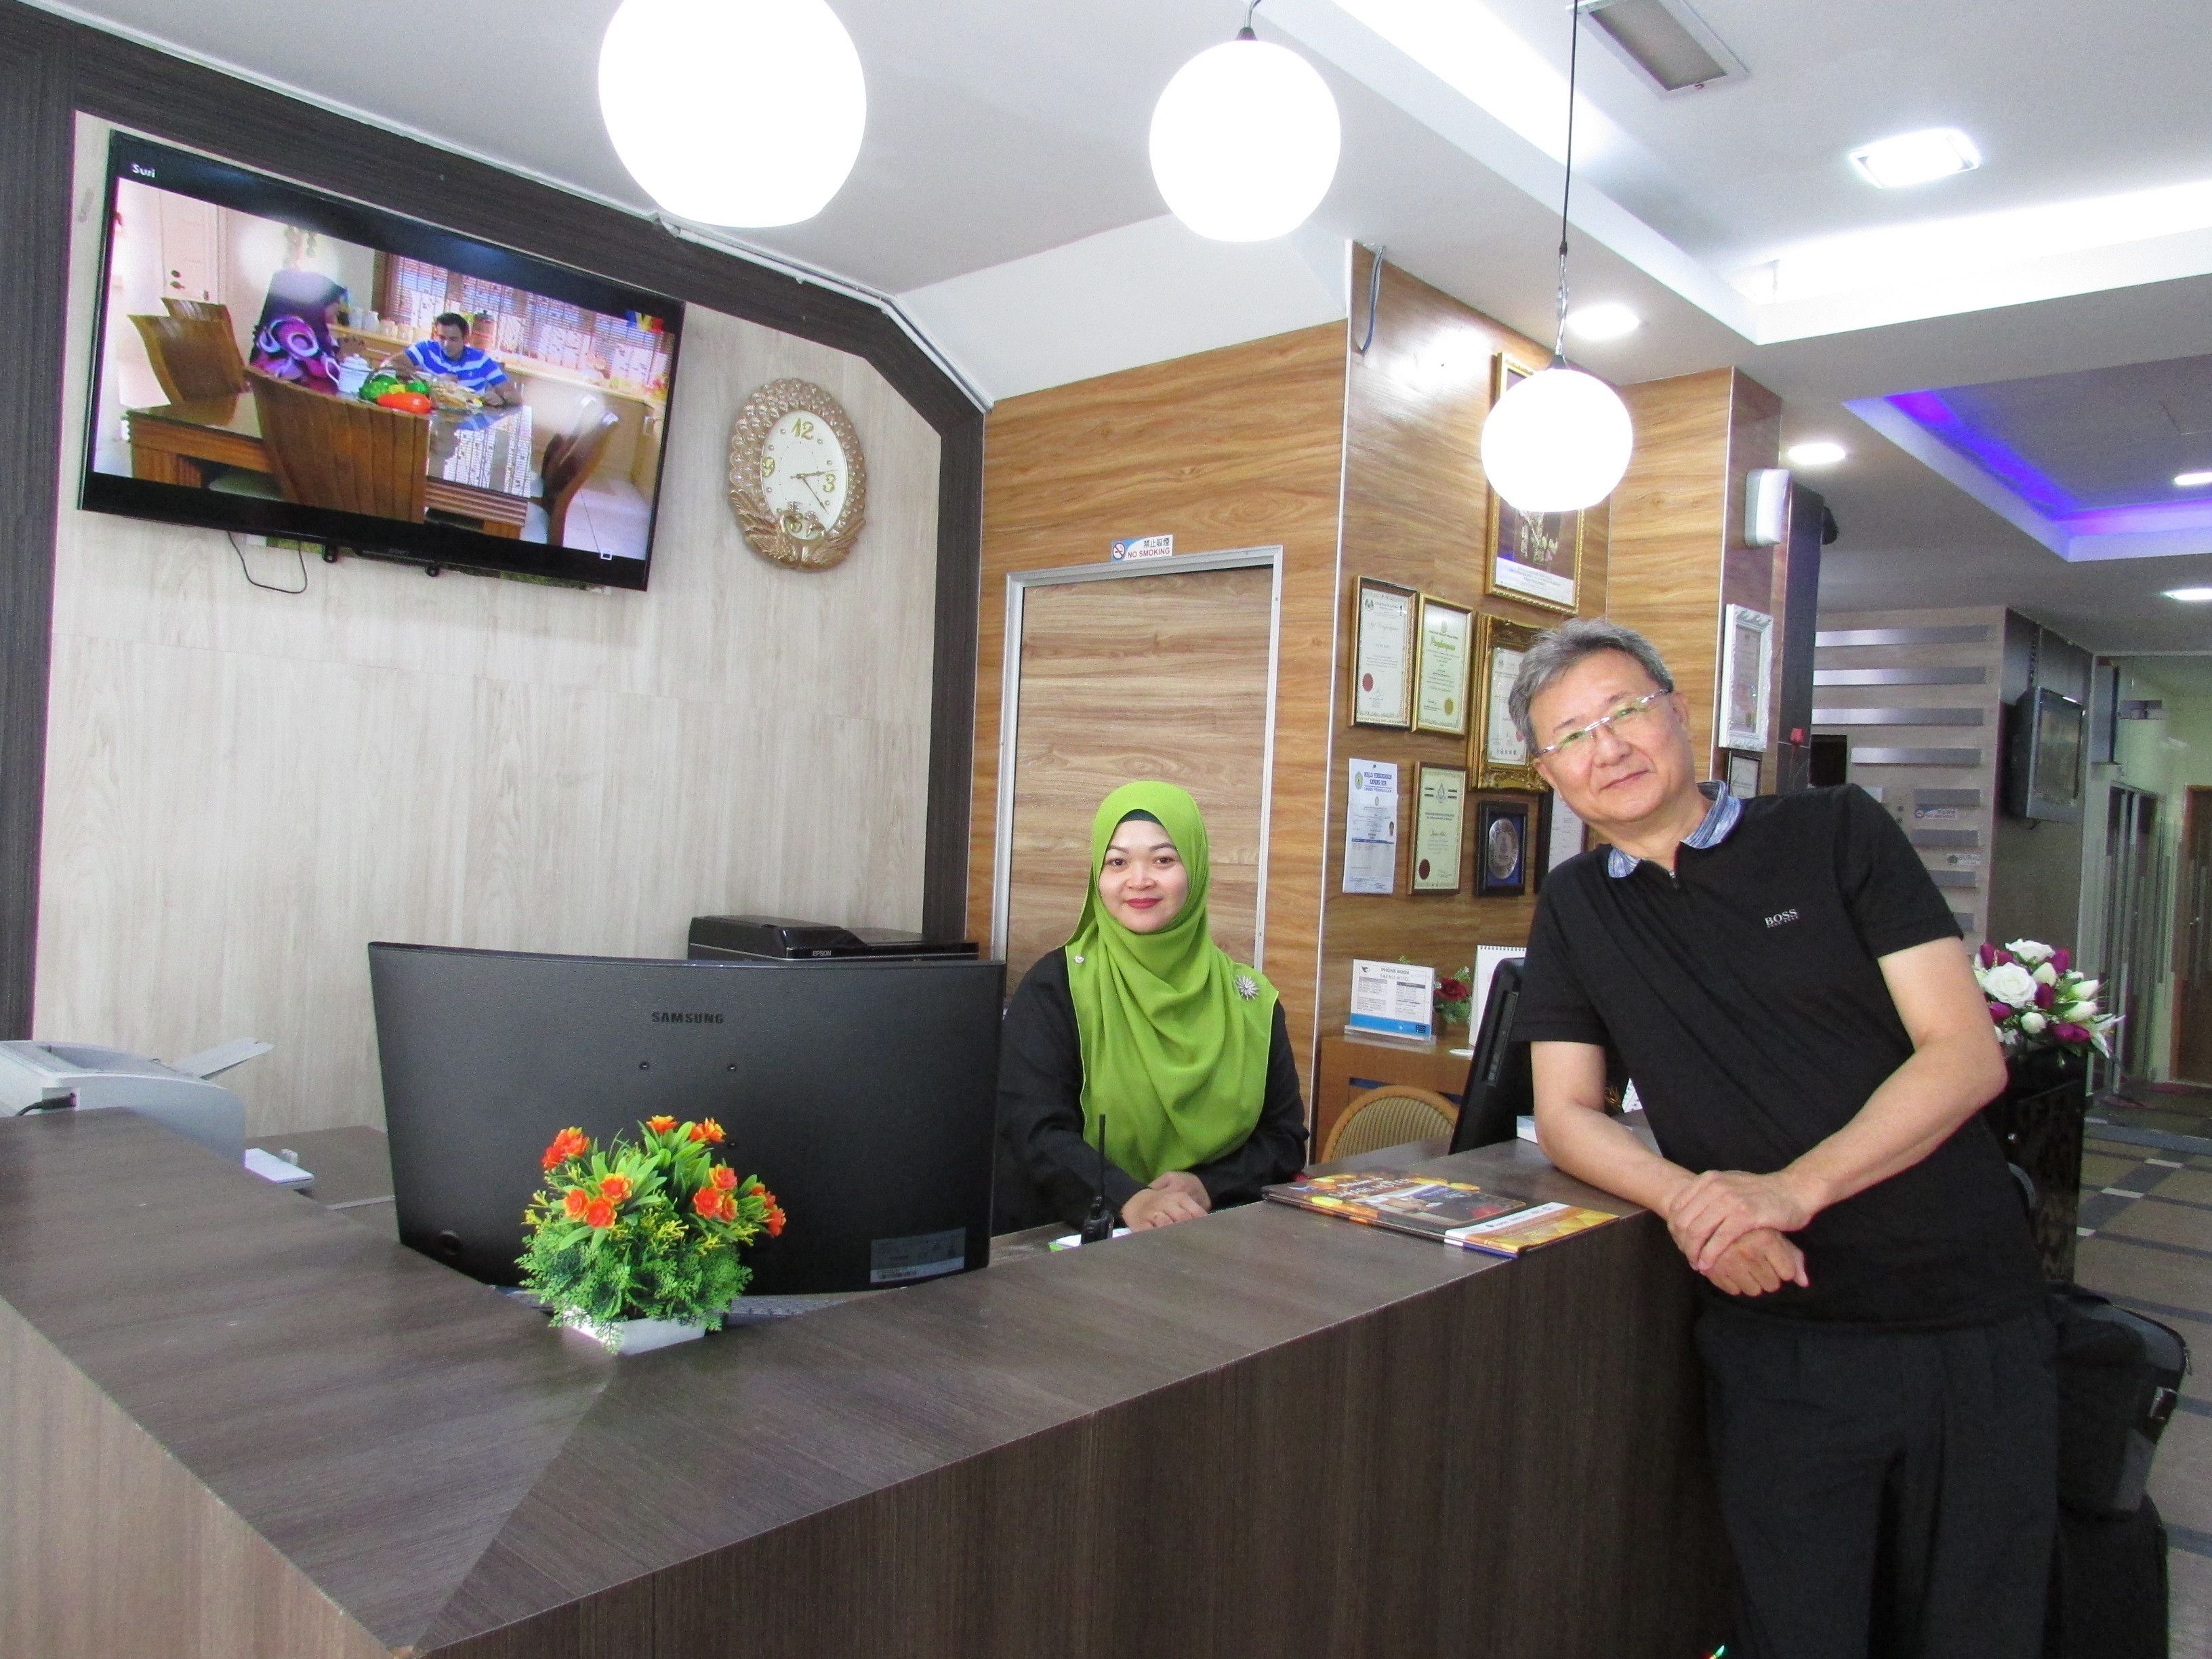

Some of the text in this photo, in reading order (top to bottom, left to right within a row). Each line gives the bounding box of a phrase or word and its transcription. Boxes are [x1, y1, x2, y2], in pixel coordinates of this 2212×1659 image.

[133, 163, 155, 178] Suri
[792, 417, 814, 441] 12
[823, 473, 836, 493] 3
[1139, 548, 1170, 557] SMOKING
[1764, 909, 1797, 926] BOSS
[651, 1012, 724, 1023] SAMSUNG
